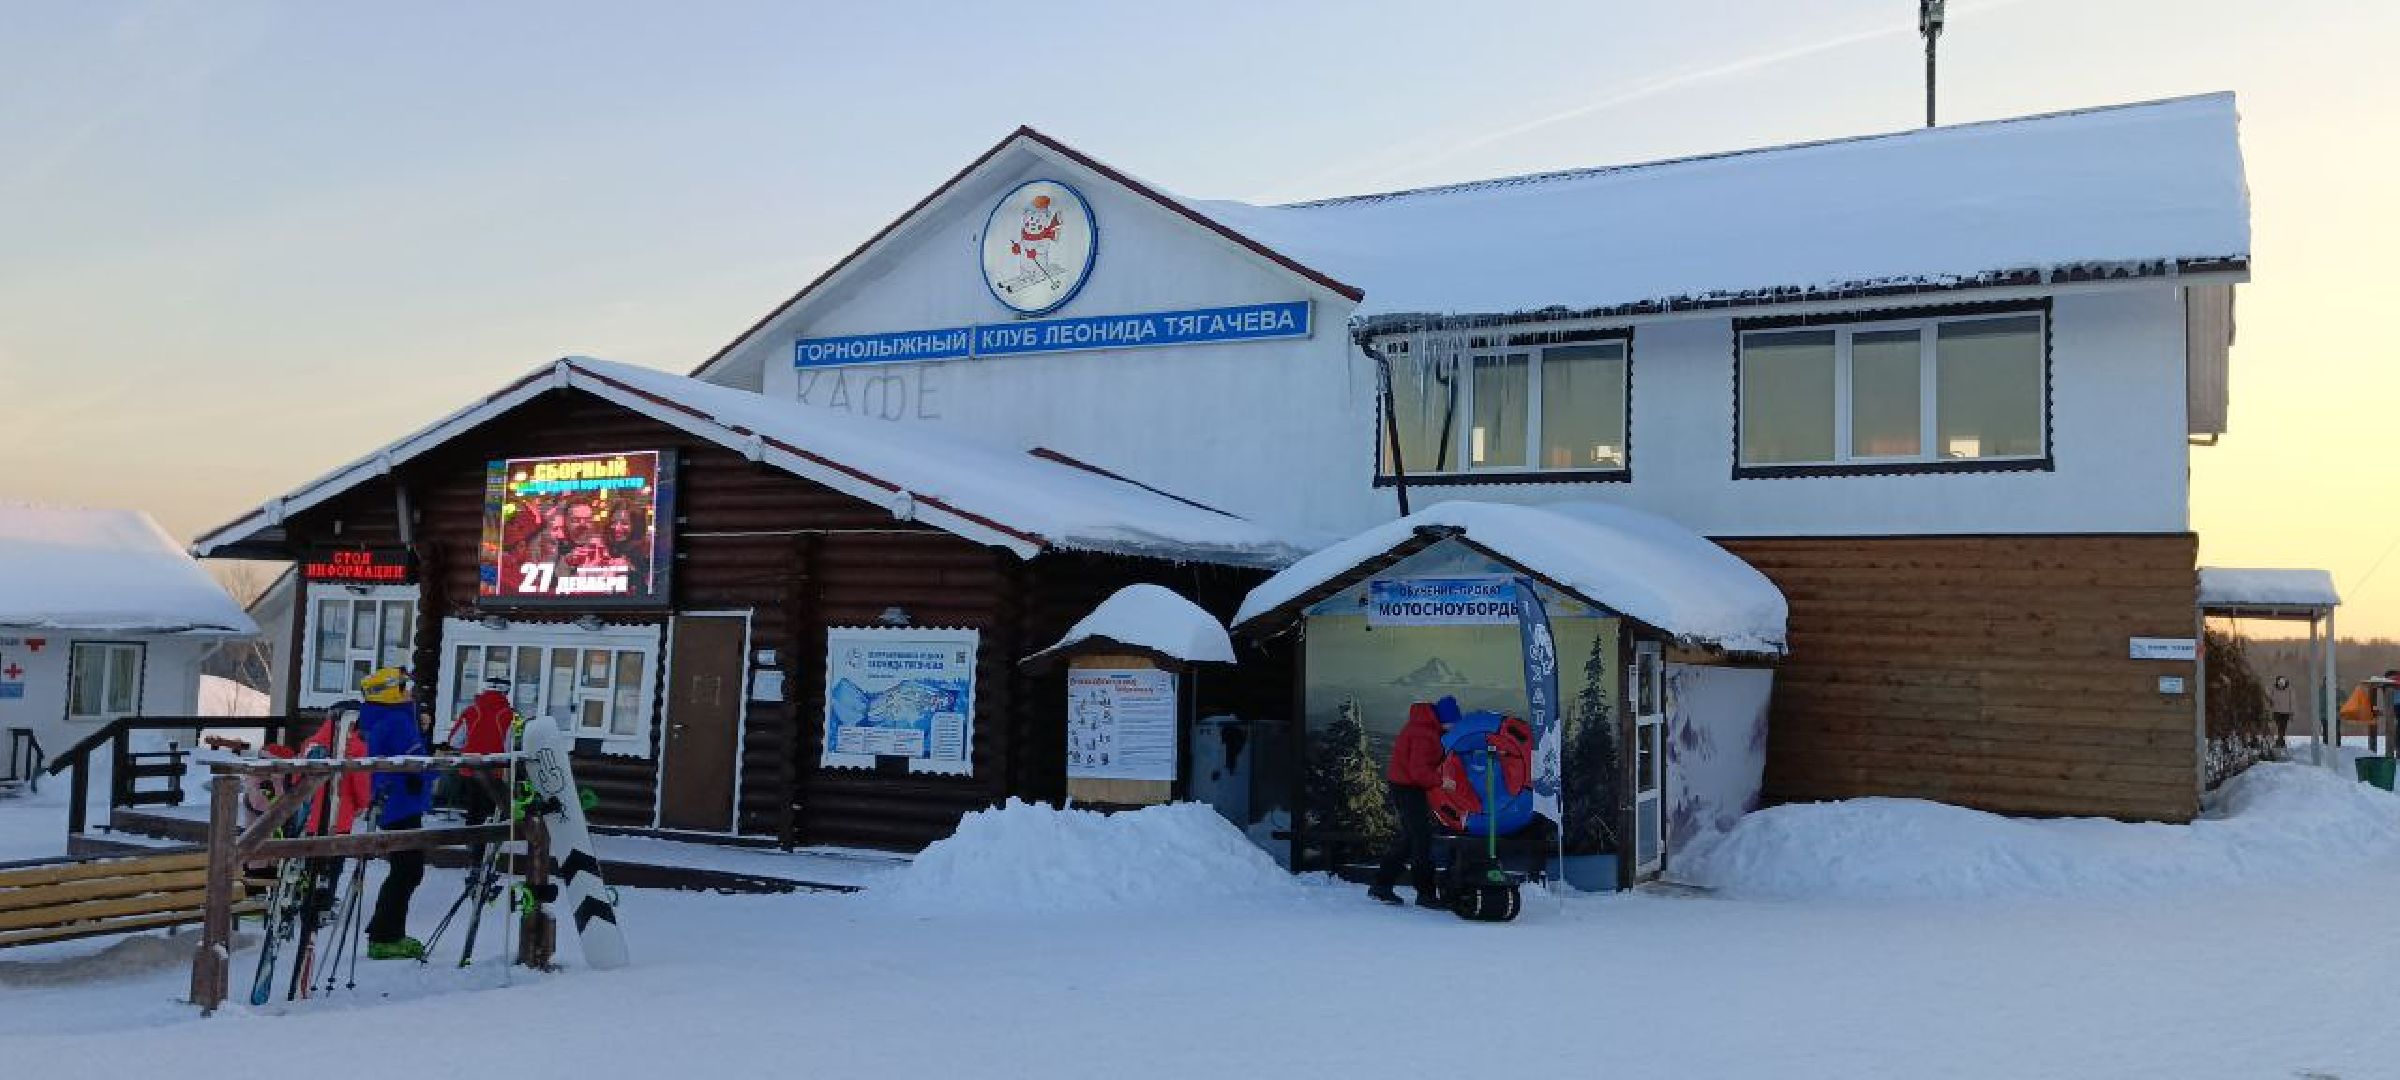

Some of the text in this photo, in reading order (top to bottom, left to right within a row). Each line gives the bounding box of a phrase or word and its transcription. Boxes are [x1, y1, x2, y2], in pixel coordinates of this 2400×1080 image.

[796, 307, 1295, 363] ГОРНОЛЫЖНЫЙ КЛУБ ЛЕОНИДА ТЯГАЧЕВА
[796, 367, 942, 421] КАФЕ
[334, 552, 371, 564] СТОЛ
[518, 562, 554, 593] 27
